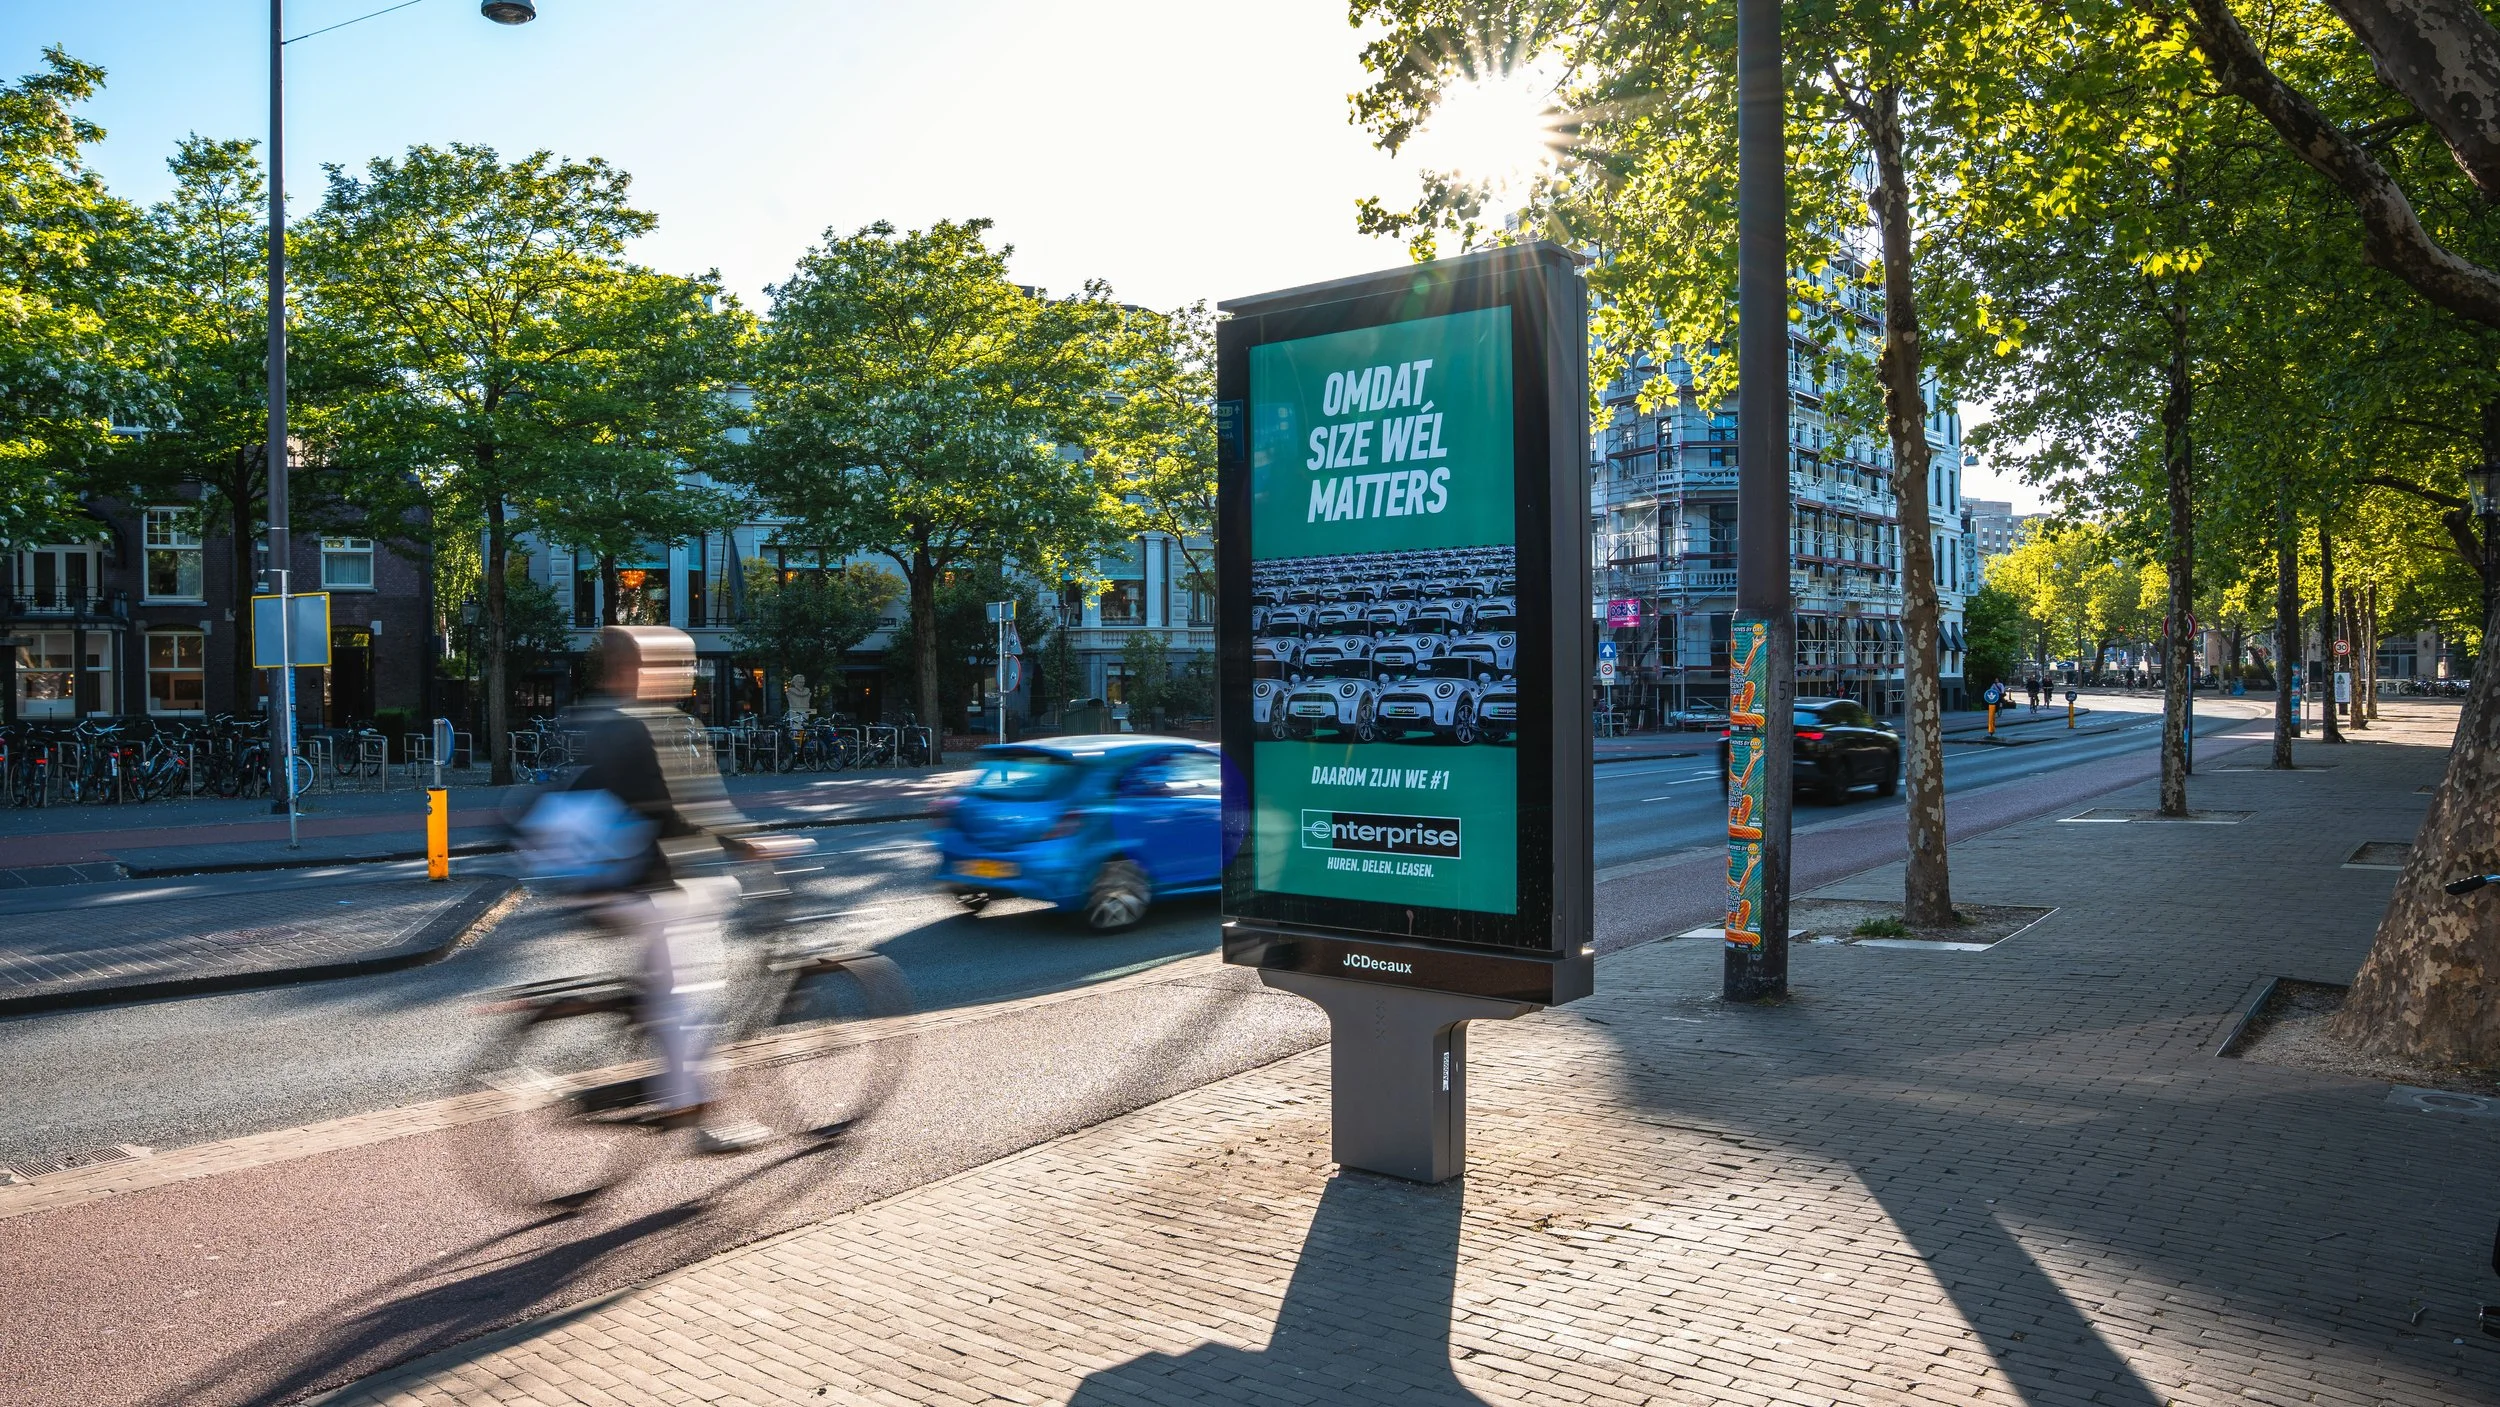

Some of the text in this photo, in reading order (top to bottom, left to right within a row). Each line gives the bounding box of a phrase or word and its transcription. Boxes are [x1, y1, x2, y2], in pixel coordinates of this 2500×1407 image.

[1322, 358, 1434, 417] OMDAT
[1306, 399, 1448, 471] SIZE WÉL
[1307, 466, 1451, 523] MATTERS
[1964, 535, 1976, 595] HOTEL
[1311, 765, 1450, 790] DAAROM ZIJN WE #1
[1310, 820, 1458, 849] enterprise
[1327, 856, 1434, 878] HUREN. DELEN. LEASEN.
[1343, 953, 1413, 974] JCDecaux
